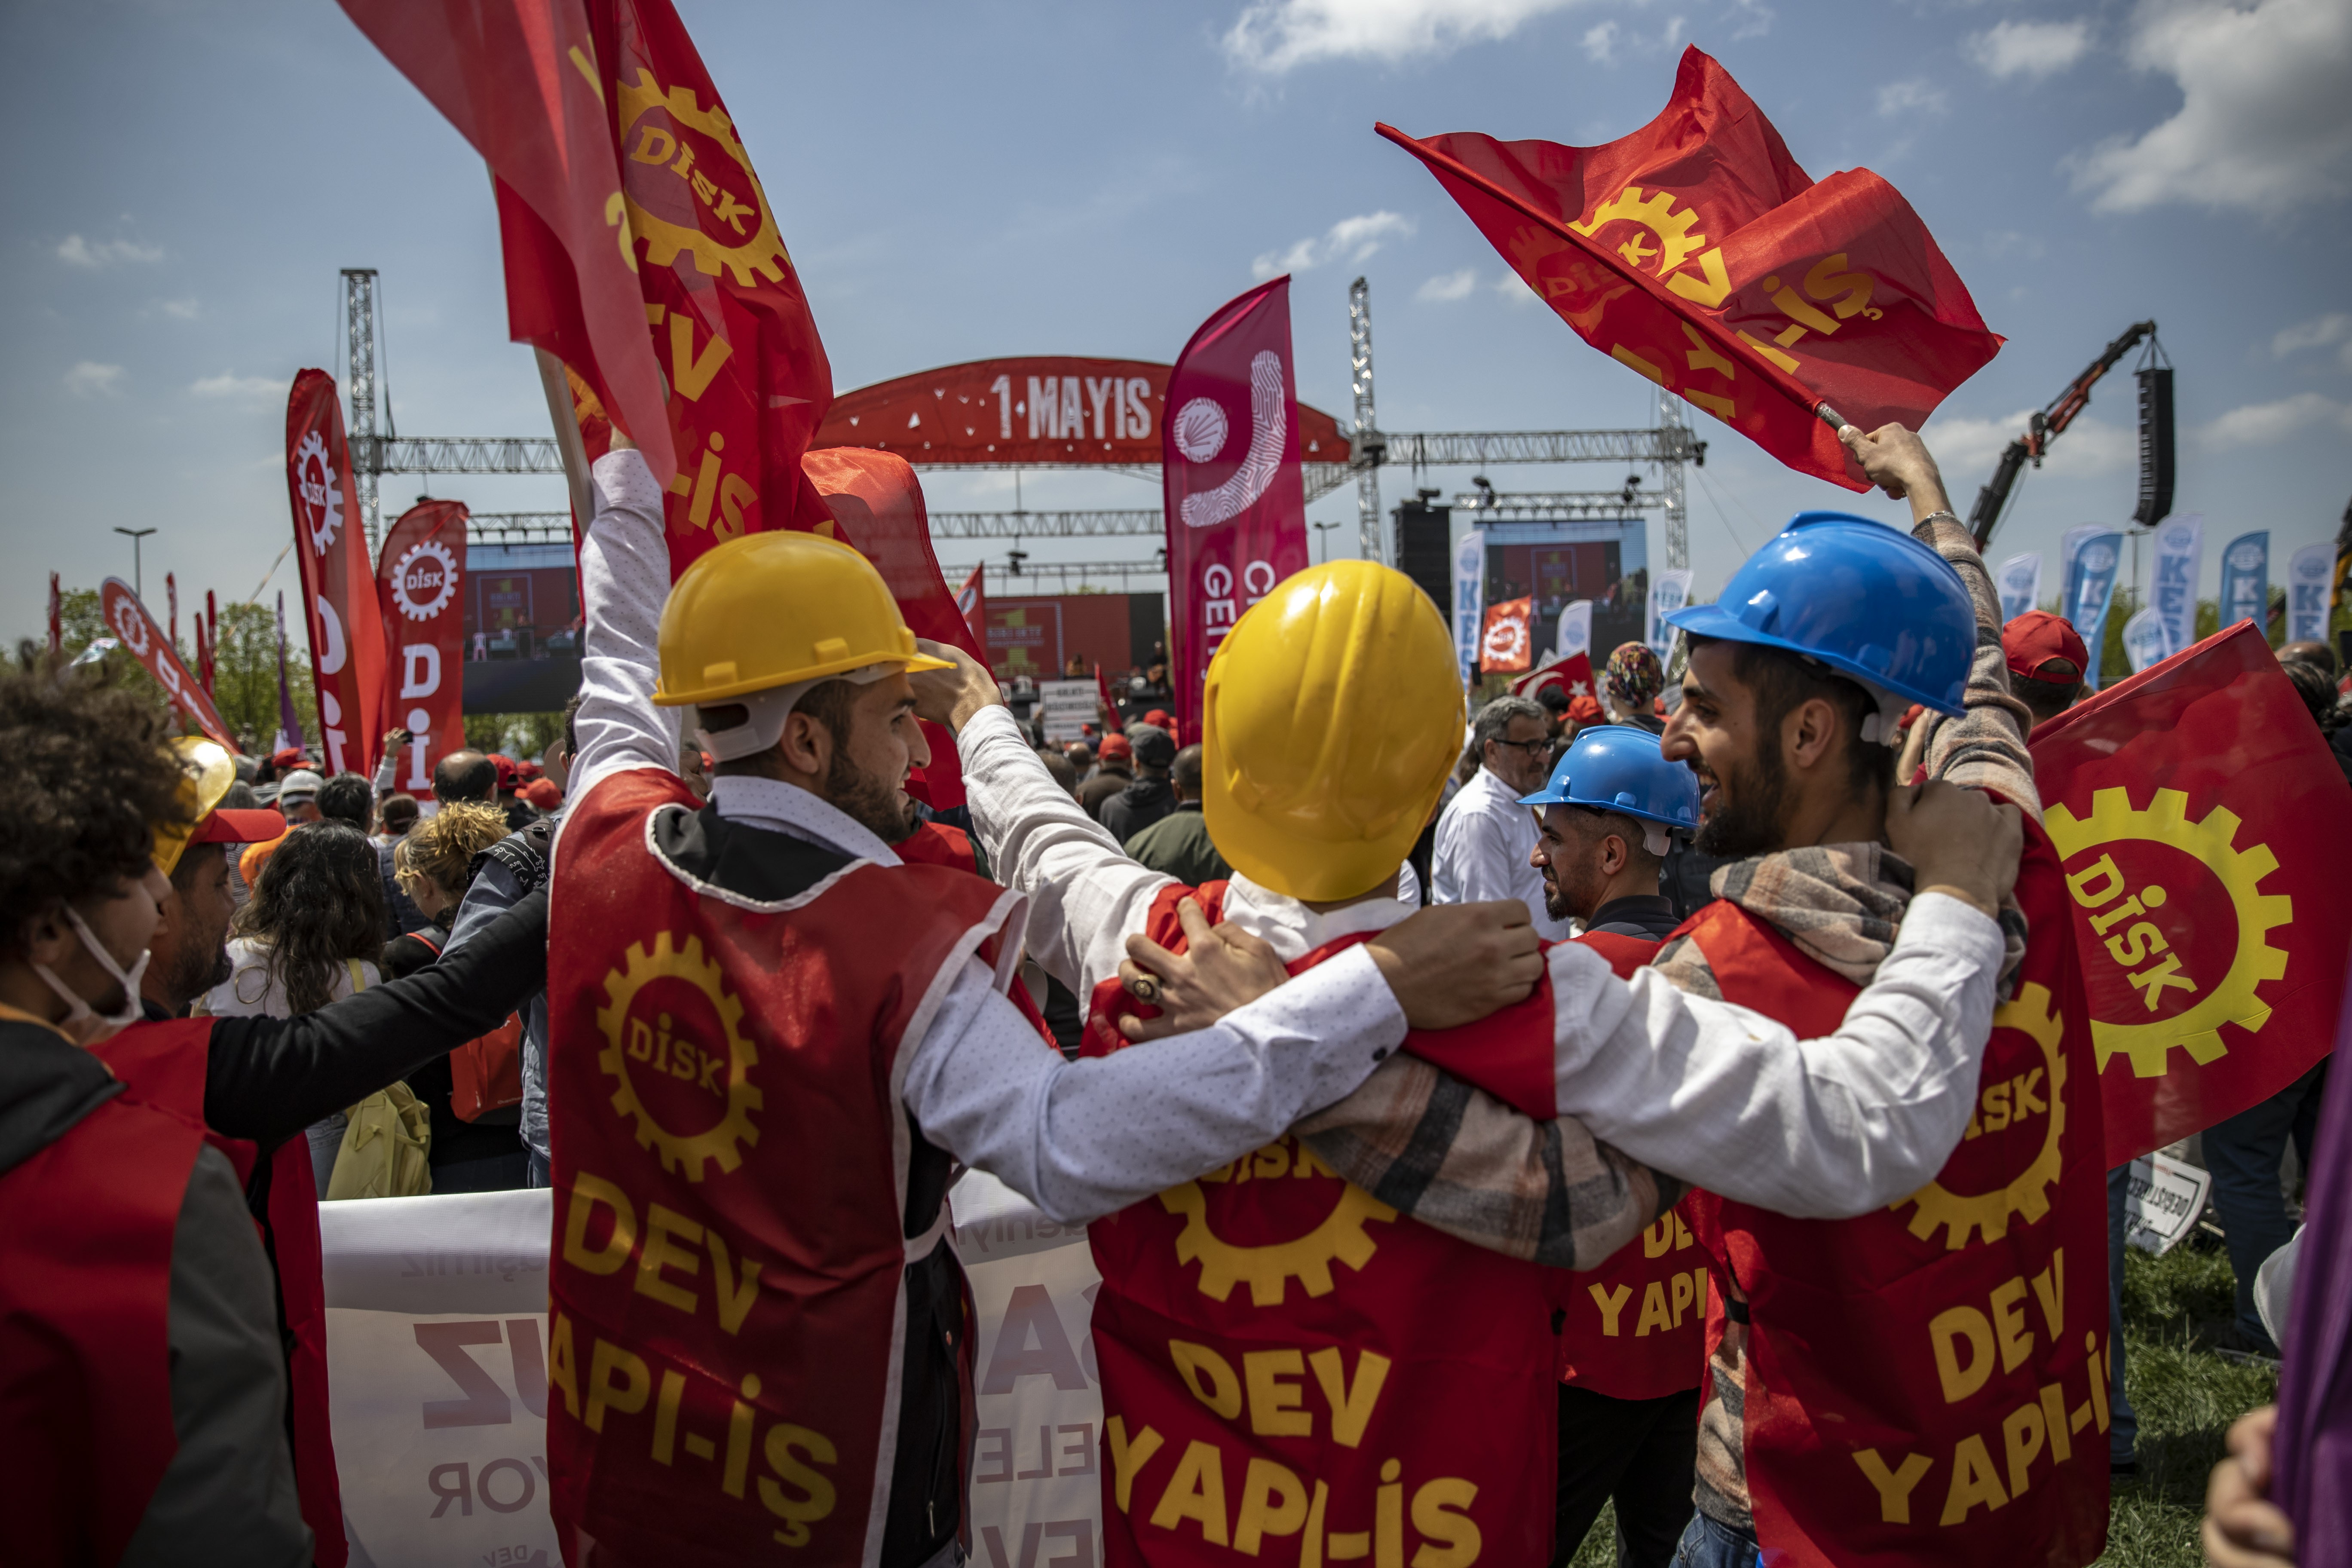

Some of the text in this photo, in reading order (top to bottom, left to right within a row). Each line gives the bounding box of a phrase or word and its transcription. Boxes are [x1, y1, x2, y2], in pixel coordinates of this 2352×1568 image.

[989, 374, 1152, 440] 1 MAYIS
[1965, 1067, 2047, 1141] SK
[563, 1171, 763, 1336] DEV
[1588, 1268, 1707, 1337] YAPI
[1929, 1246, 2064, 1404] DEV
[548, 1302, 837, 1547] API-İŞ
[1169, 1339, 1391, 1448] DEV
